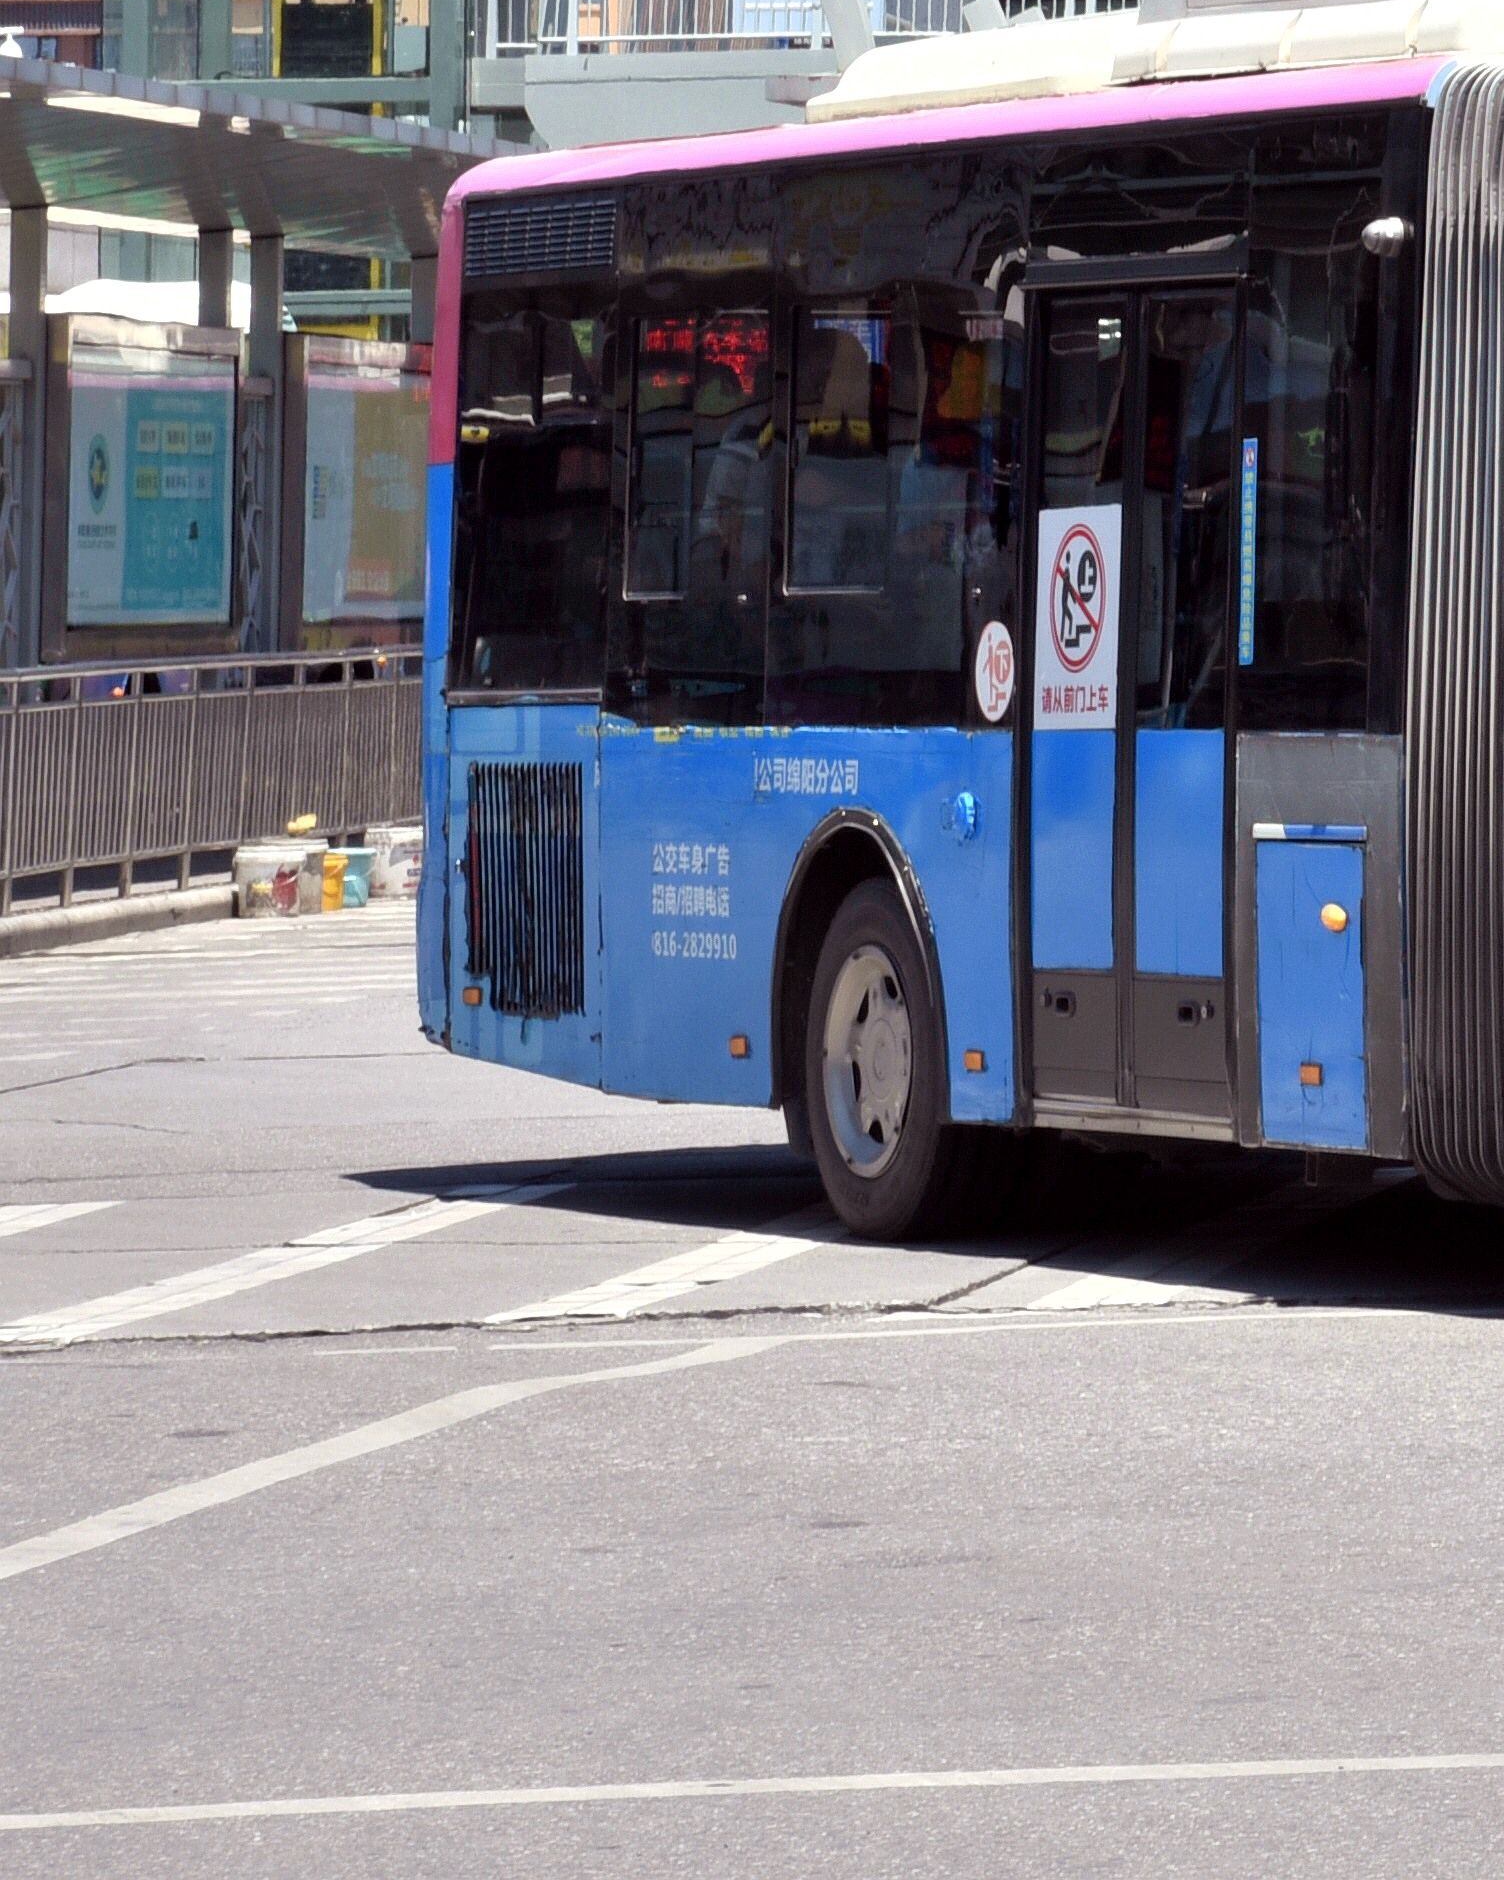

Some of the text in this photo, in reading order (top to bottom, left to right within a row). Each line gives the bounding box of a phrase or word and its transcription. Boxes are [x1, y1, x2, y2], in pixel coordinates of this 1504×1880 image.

[1041, 682, 1109, 714] 请从前门上车
[754, 757, 859, 796] 公司绵阳分公司
[652, 841, 731, 876] 公交车身广告
[652, 883, 731, 918] 招商/招聘电话
